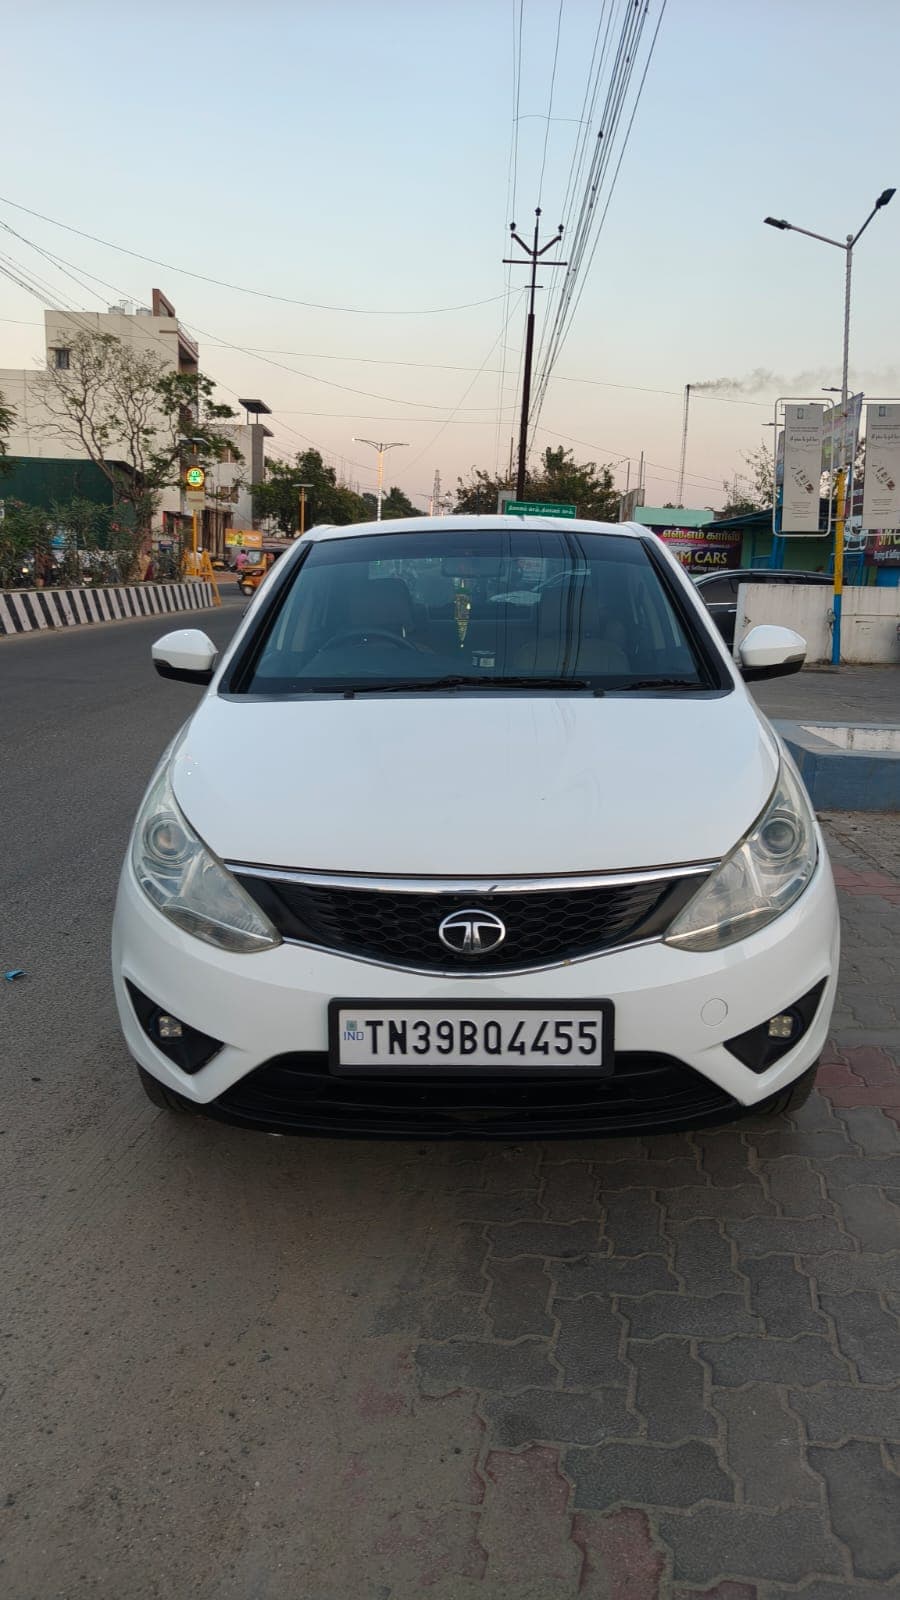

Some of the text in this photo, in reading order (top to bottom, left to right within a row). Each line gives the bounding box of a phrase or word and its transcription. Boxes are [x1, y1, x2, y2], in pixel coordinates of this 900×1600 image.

[694, 551, 728, 564] CARS
[343, 1020, 597, 1055] IND TN39BQ4455
